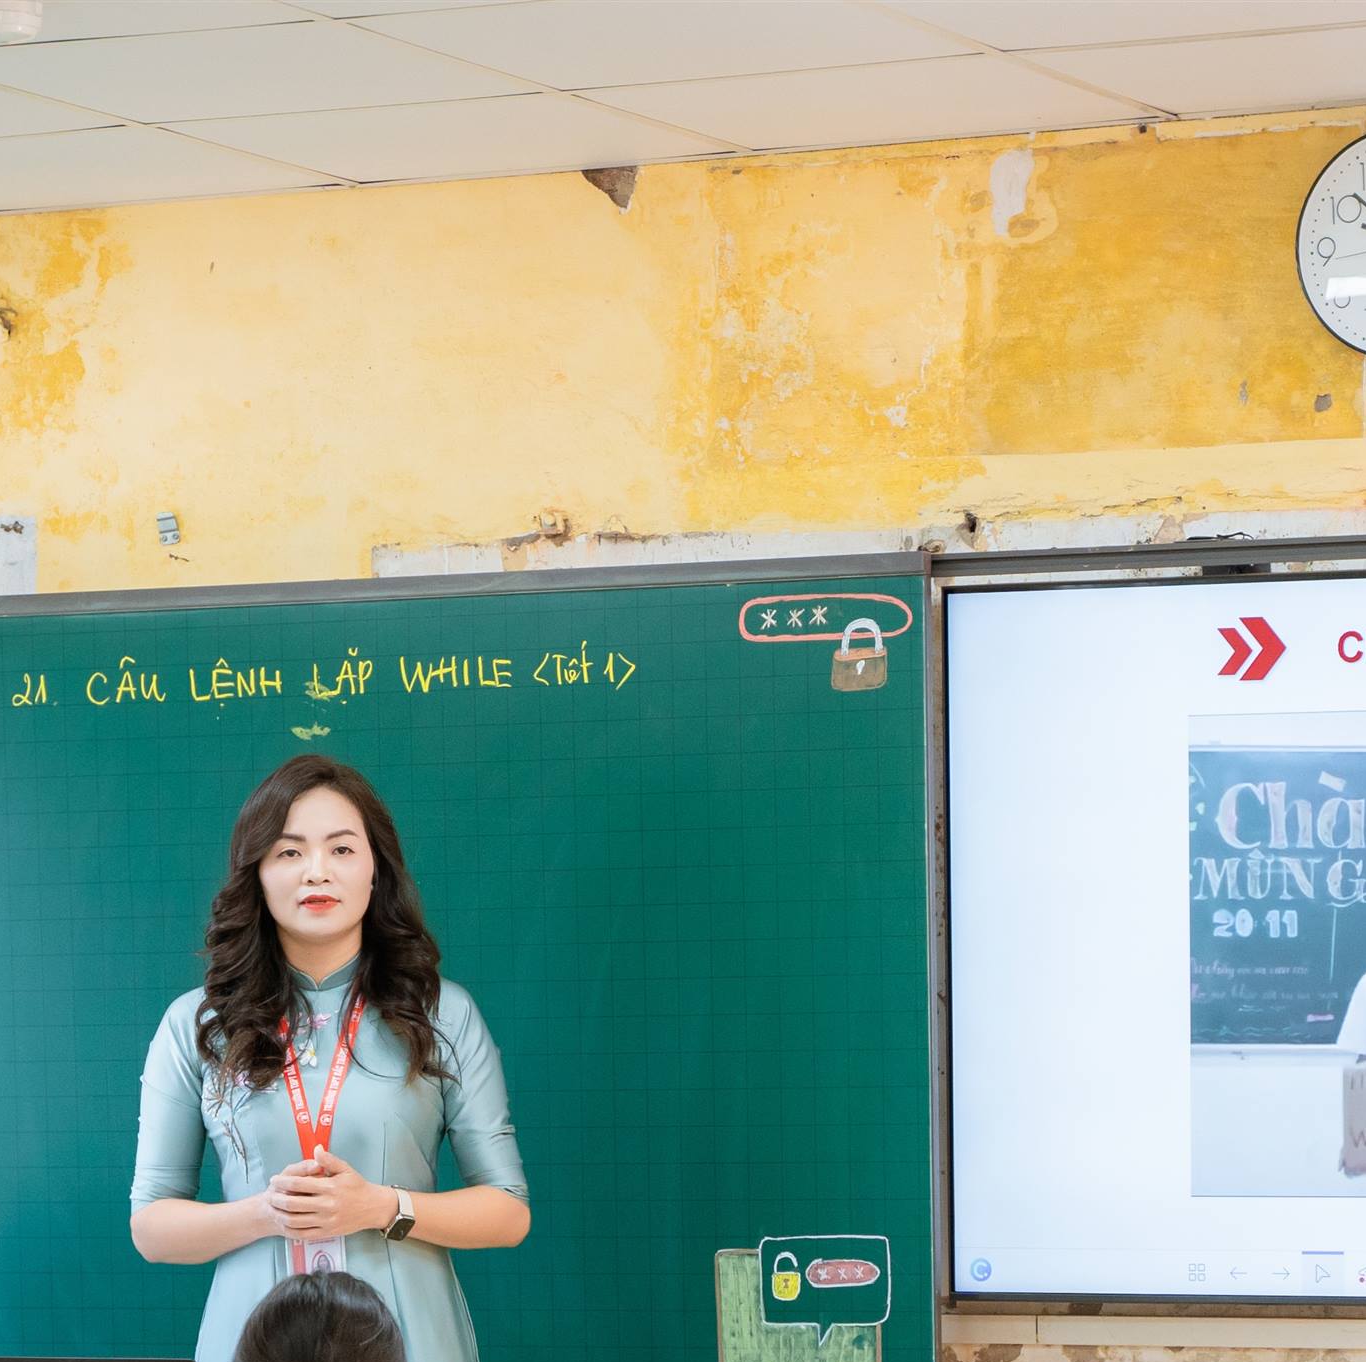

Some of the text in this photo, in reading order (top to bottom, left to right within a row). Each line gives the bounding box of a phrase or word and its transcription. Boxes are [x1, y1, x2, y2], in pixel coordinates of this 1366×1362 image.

[1329, 194, 1362, 225] 10
[1316, 236, 1336, 267] 9
[86, 655, 166, 705] CÂU
[189, 657, 283, 707] LỆNH
[312, 647, 373, 705] LẶP
[399, 655, 512, 693] WHILE
